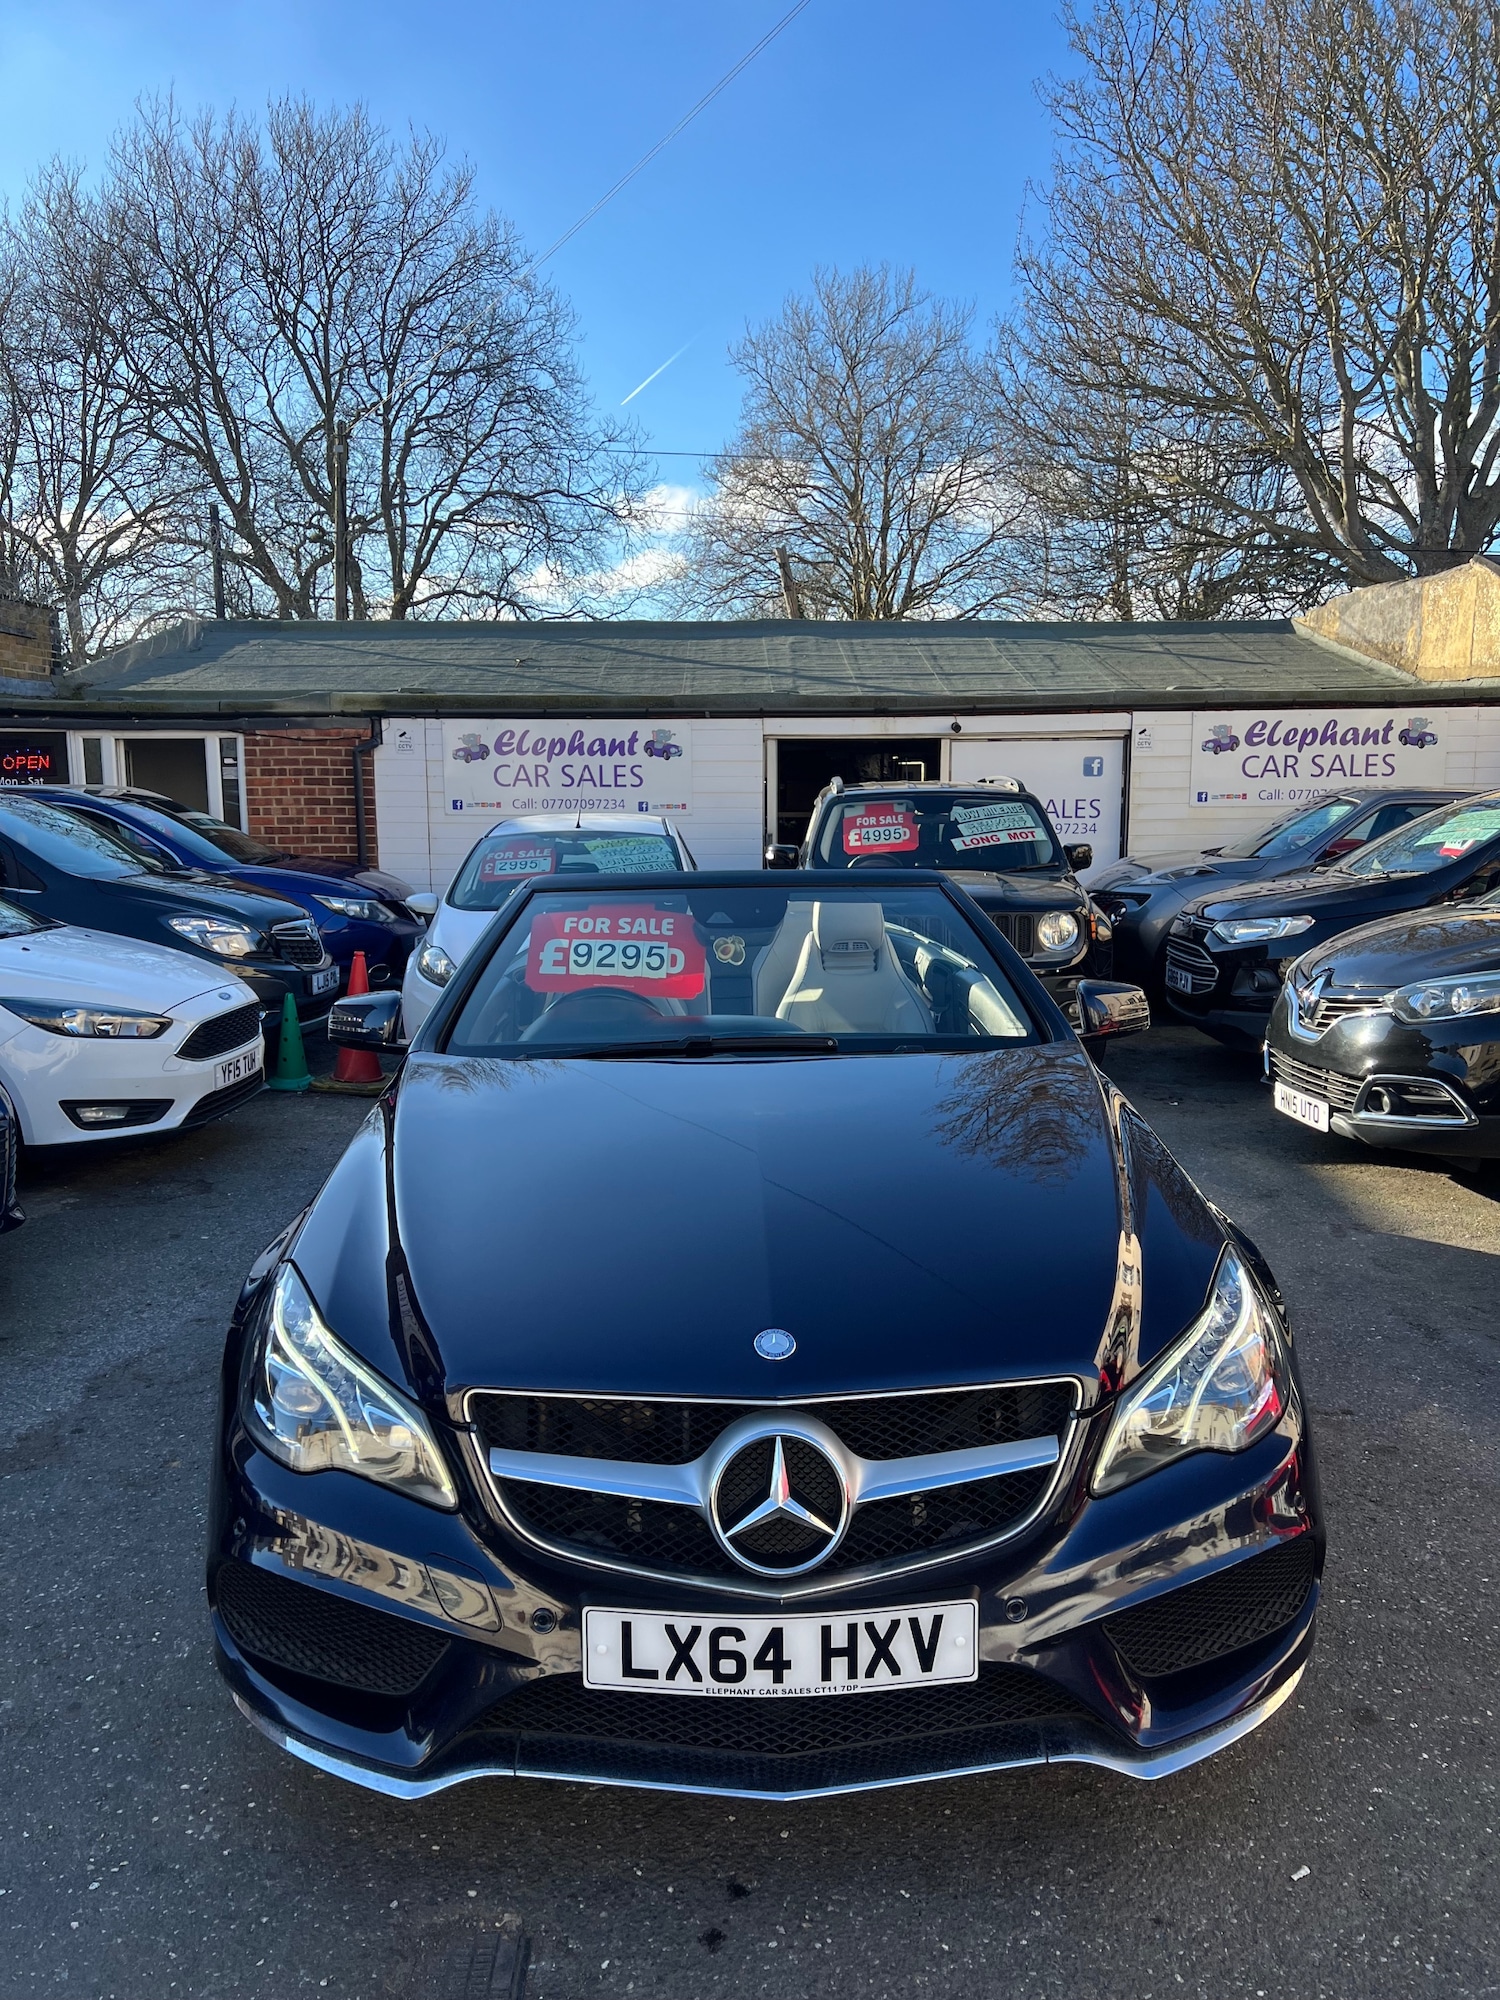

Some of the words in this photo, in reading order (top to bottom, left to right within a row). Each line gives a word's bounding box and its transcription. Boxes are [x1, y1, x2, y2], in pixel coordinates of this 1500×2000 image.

[1244, 719, 1394, 753] Elephant
[493, 729, 639, 763] Elephant
[3, 755, 49, 769] OPEN
[1241, 754, 1299, 778] CAR
[1310, 753, 1396, 777] SALES
[28, 777, 44, 785] Sat
[493, 764, 551, 788] CAR
[561, 764, 644, 788] SALES
[1258, 789, 1284, 800] Call:
[512, 798, 537, 809] Call:
[541, 799, 626, 809] 07707097234
[1045, 798, 1102, 819] ALES
[856, 817, 877, 826] FOR
[879, 814, 904, 825] SALE
[1055, 823, 1098, 834] 97234
[961, 834, 1001, 847] LONG
[1007, 831, 1036, 841] MOT
[486, 851, 514, 860] FOR
[518, 848, 552, 858] SALE
[564, 917, 611, 934] FOR
[618, 917, 675, 935] SALE
[221, 1058, 241, 1083] YF15
[1301, 1098, 1319, 1123] UTO
[621, 1619, 791, 1684] LX64
[820, 1614, 945, 1682] HXV
[705, 1687, 756, 1696] ELEPHANT
[758, 1688, 778, 1696] CAR
[781, 1687, 812, 1695] SALES
[814, 1685, 838, 1694] CT11
[840, 1684, 859, 1692] 7DP
